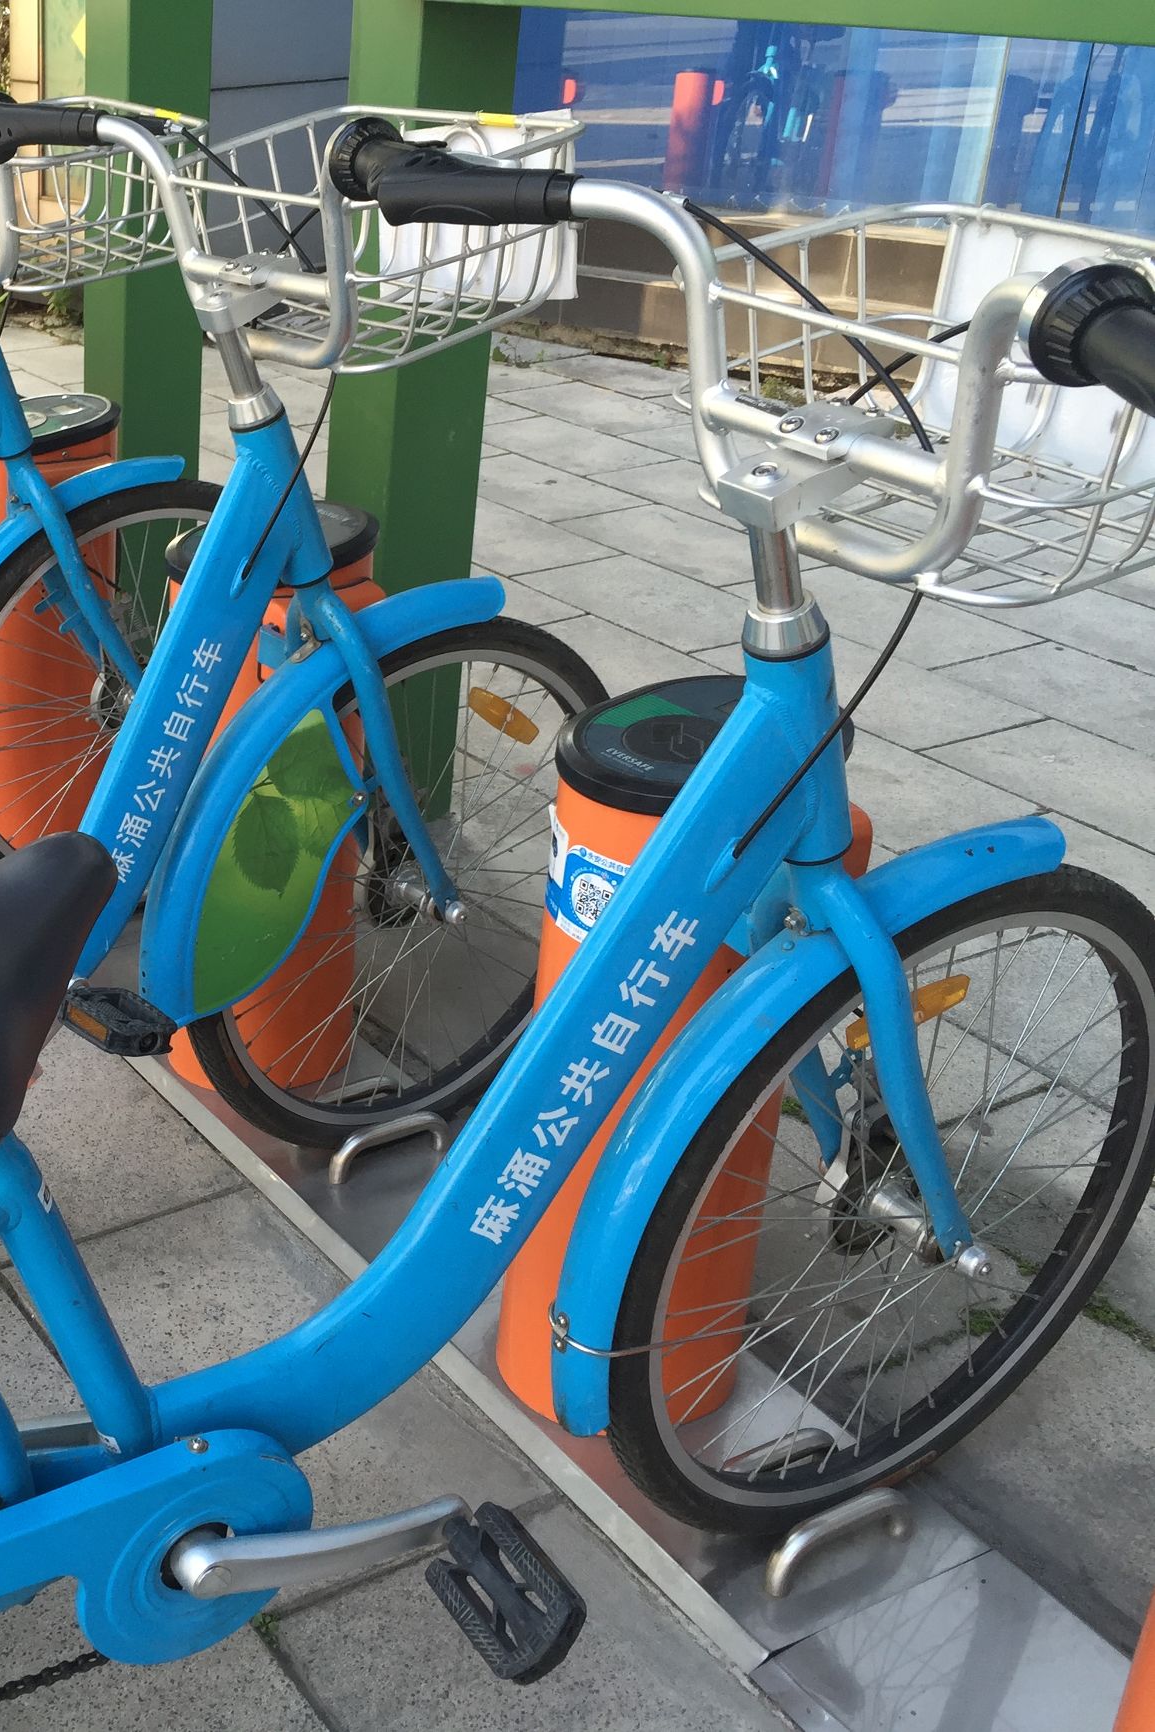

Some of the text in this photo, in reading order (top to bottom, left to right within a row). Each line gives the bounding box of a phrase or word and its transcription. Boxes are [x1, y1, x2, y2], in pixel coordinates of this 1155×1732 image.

[111, 638, 223, 883] 麻涌公共自行车
[605, 747, 655, 772] EVERSAFE
[469, 910, 699, 1244] 麻涌公共自行车
